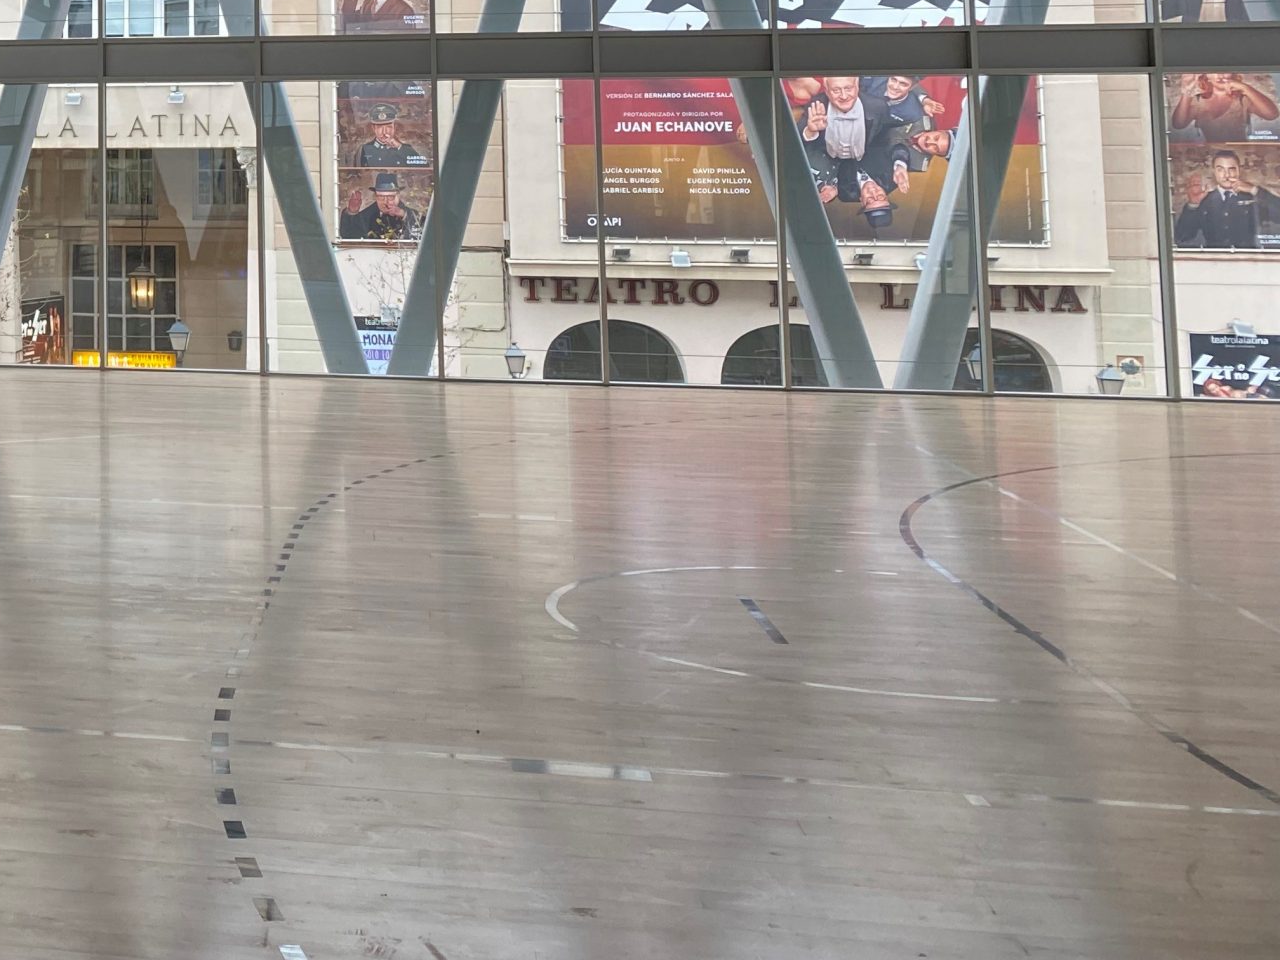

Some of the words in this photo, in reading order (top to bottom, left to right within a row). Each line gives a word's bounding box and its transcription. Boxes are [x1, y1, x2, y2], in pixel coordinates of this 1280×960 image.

[614, 121, 651, 133] JUAN
[655, 121, 734, 133] ECHANOVE
[689, 186, 722, 194] NICOLÁS
[521, 277, 720, 307] TEATRO
[879, 283, 1088, 313] LINA
